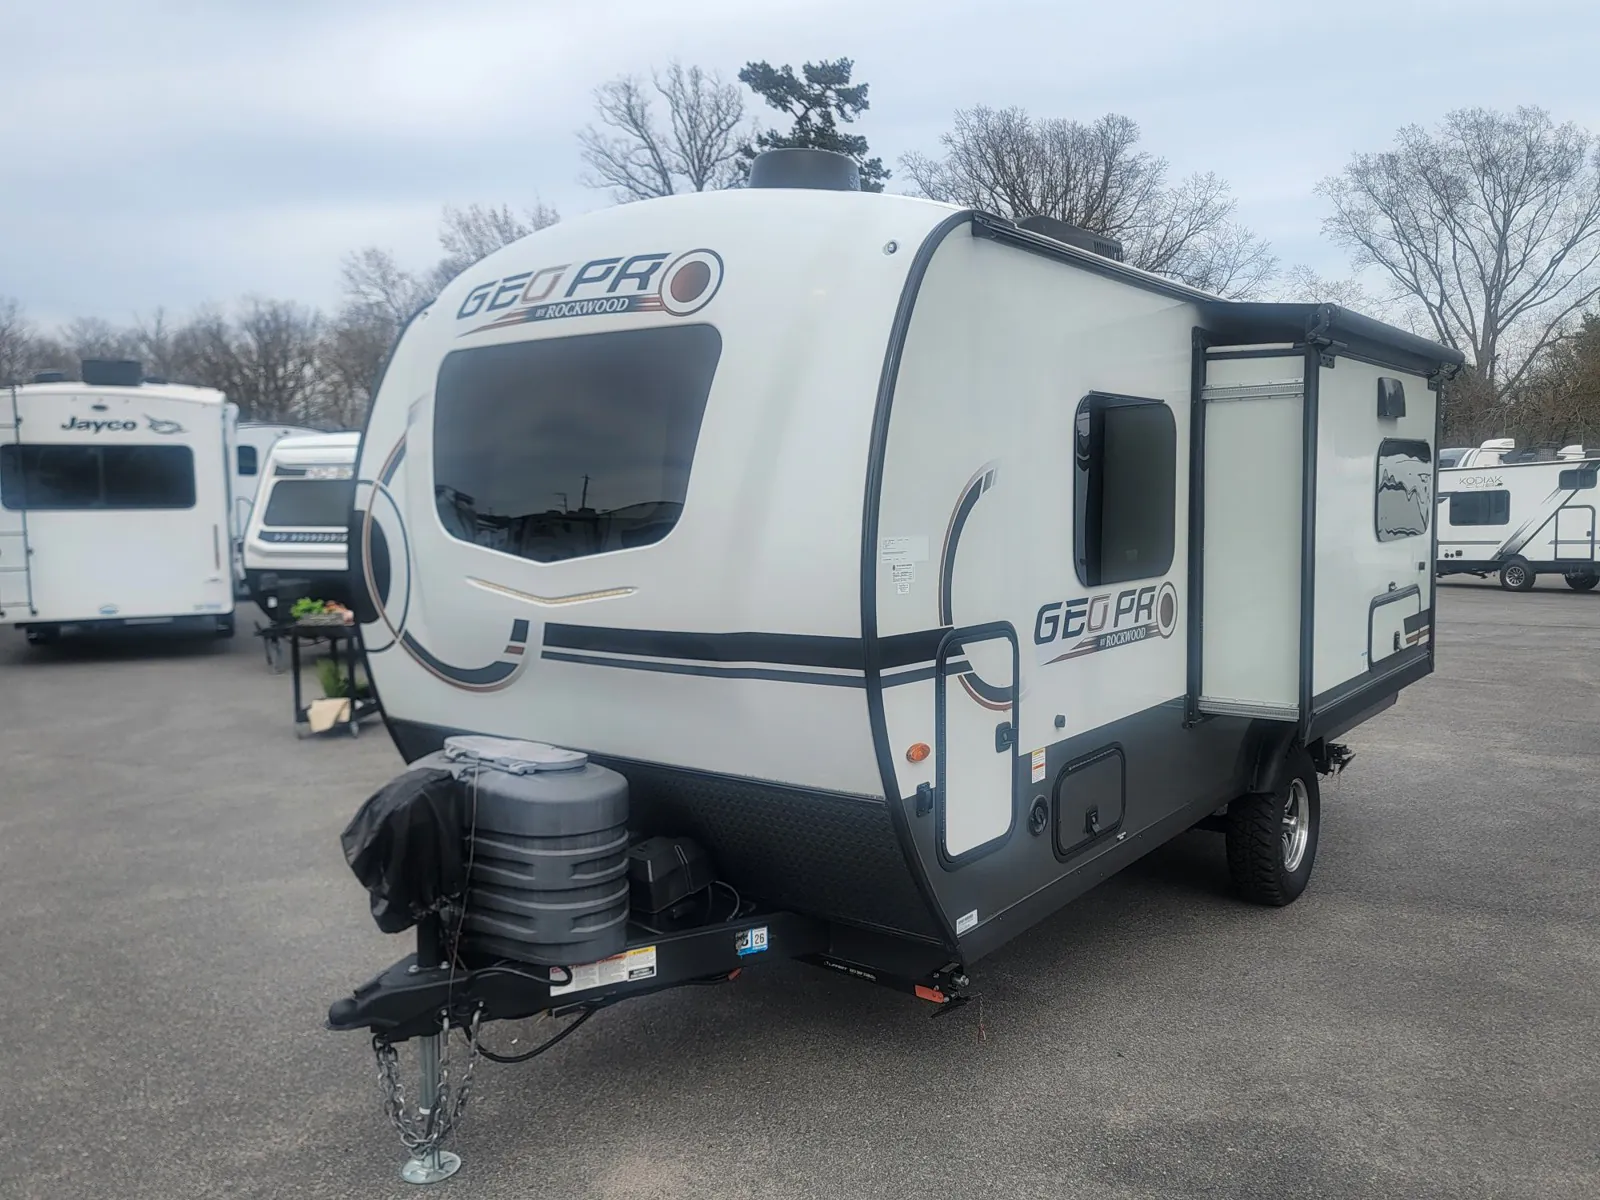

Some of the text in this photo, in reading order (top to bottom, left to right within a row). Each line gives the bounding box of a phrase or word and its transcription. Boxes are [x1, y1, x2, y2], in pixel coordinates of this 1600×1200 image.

[457, 248, 724, 320] GEO PRO
[546, 298, 629, 319] ROCKWOOD
[61, 416, 137, 434] Jayco
[1459, 476, 1503, 485] KODIAK
[1034, 581, 1178, 645] GEO PRO
[1105, 627, 1146, 648] ROCKWOOD
[754, 933, 765, 945] 26
